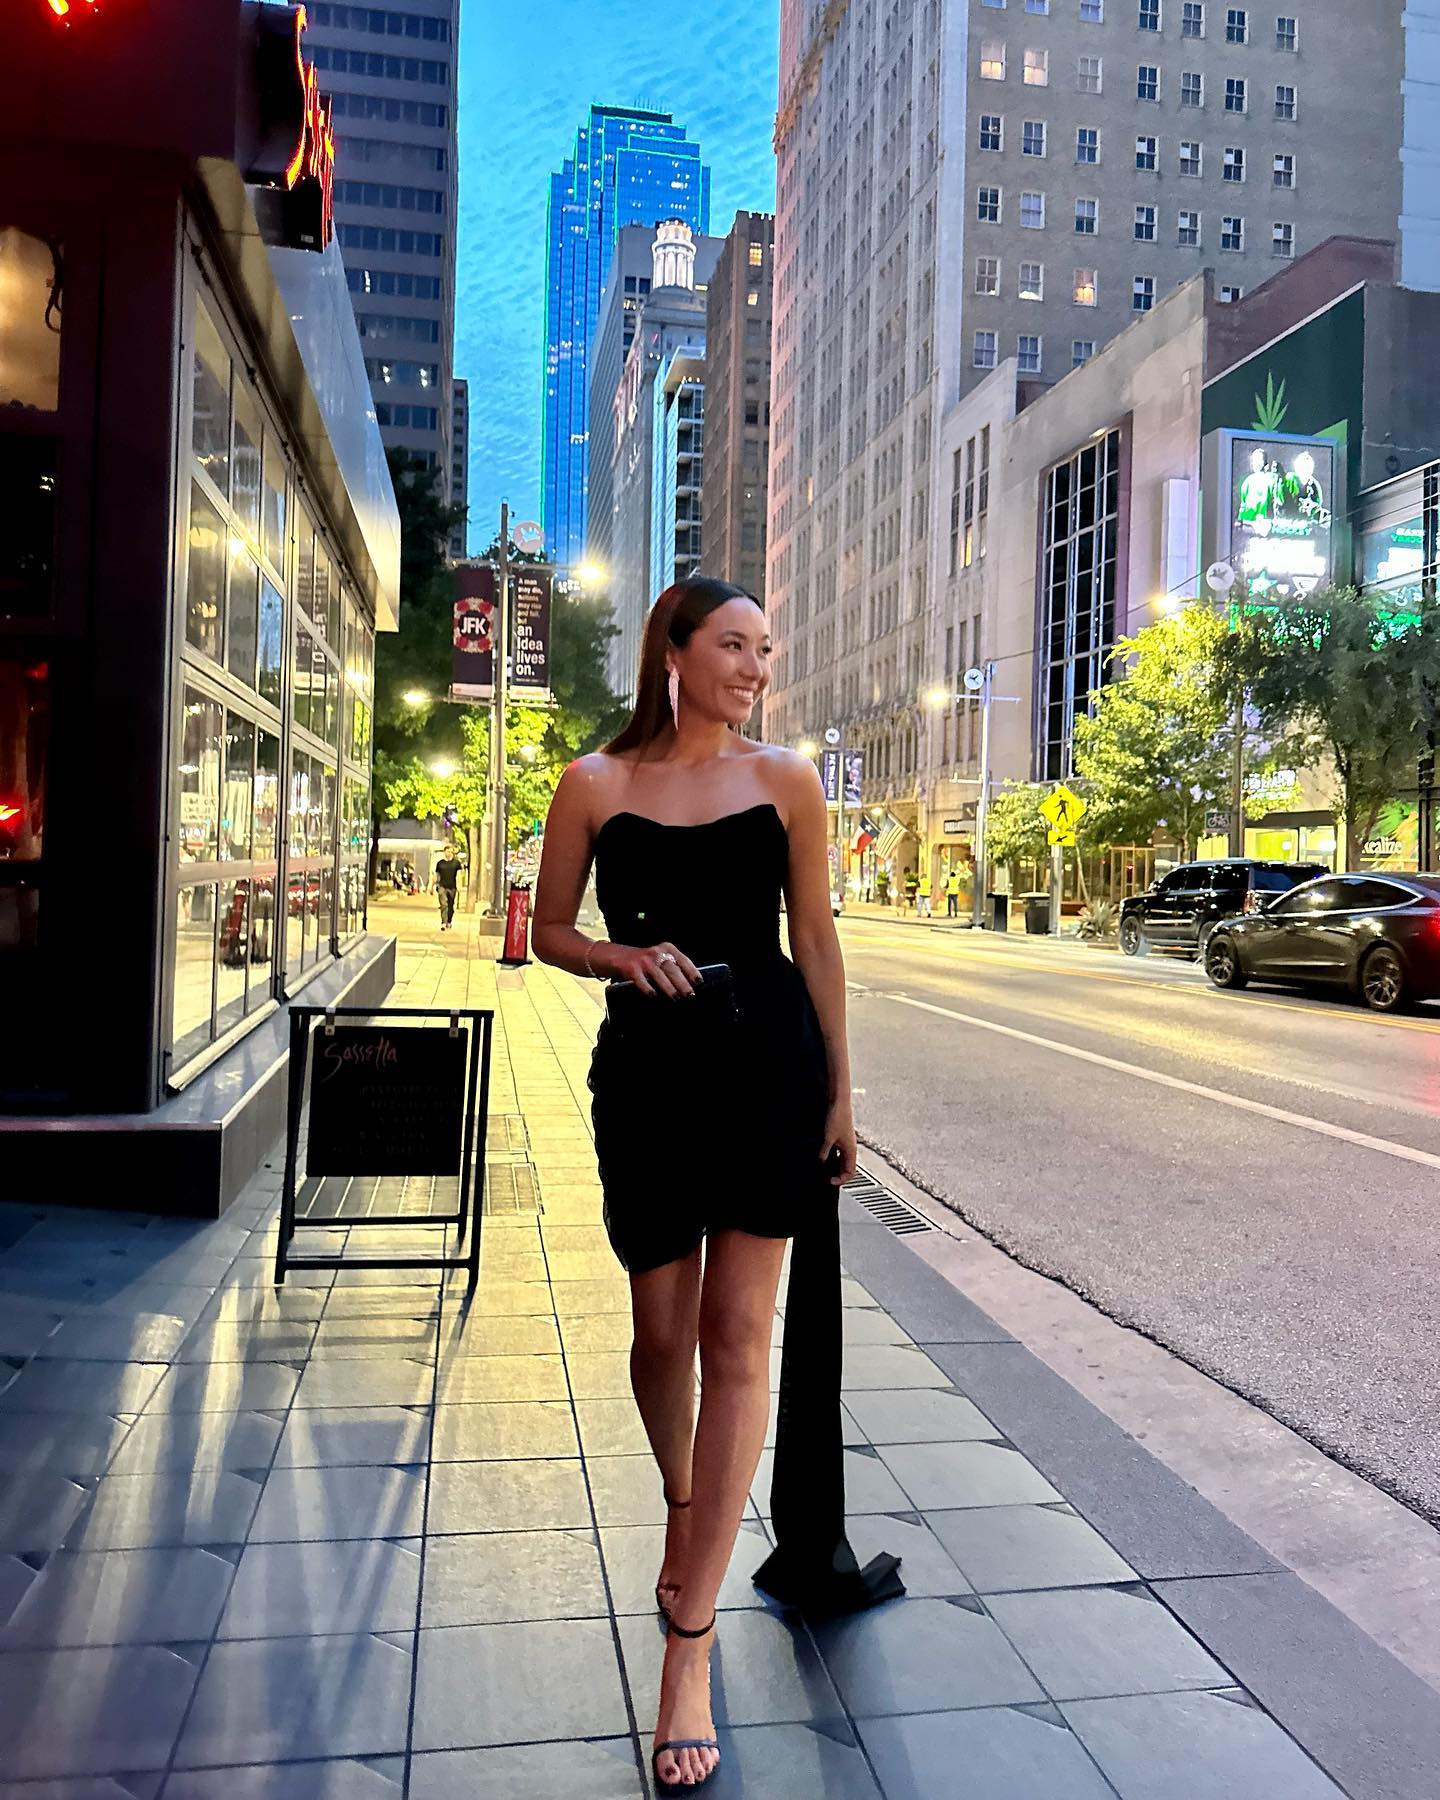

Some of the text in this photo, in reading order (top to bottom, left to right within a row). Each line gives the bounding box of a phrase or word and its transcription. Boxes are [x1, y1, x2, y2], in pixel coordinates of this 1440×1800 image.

[461, 617, 486, 635] JFK
[517, 625, 533, 637] an
[516, 637, 544, 651] idea
[516, 650, 546, 665] lives
[515, 664, 536, 676] on.
[320, 1036, 399, 1084] Sassetta
